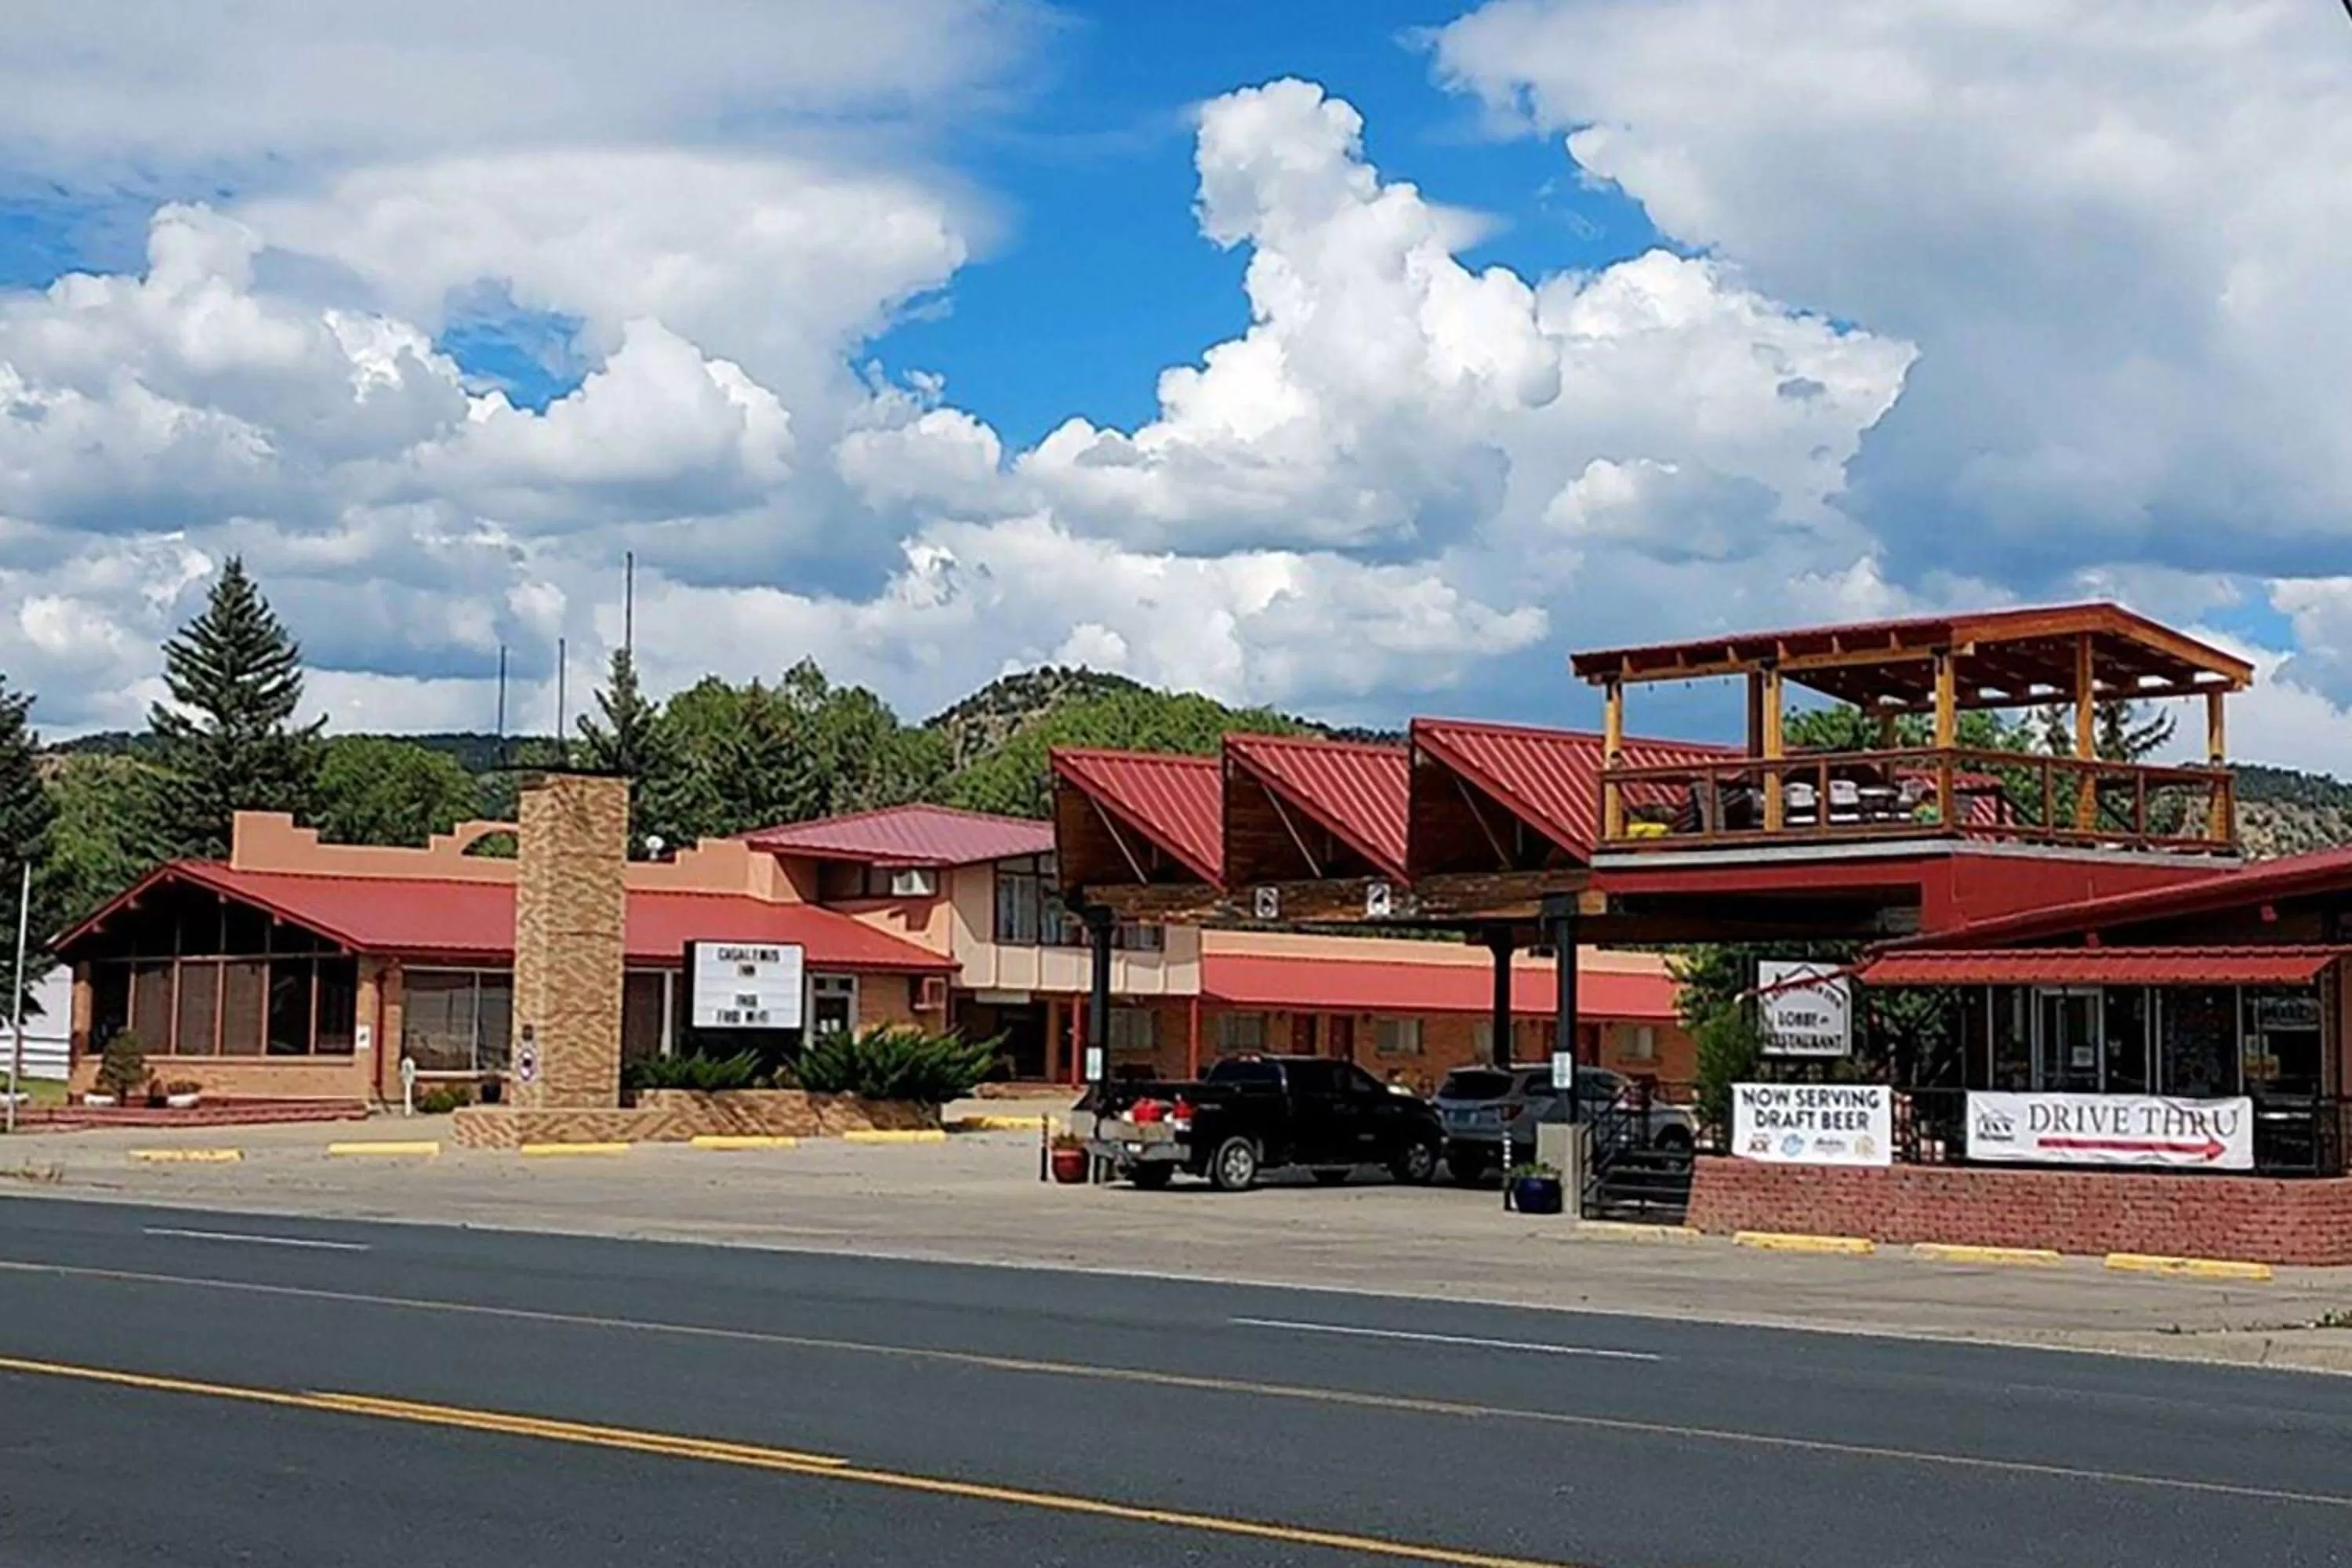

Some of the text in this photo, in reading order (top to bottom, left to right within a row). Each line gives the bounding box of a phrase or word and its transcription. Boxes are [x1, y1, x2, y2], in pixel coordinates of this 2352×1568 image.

[1741, 1087, 1880, 1109] NOW SERVING
[1755, 1109, 1870, 1131] DRAFT BEER
[2028, 1102, 2238, 1138] DRIVE THRU
